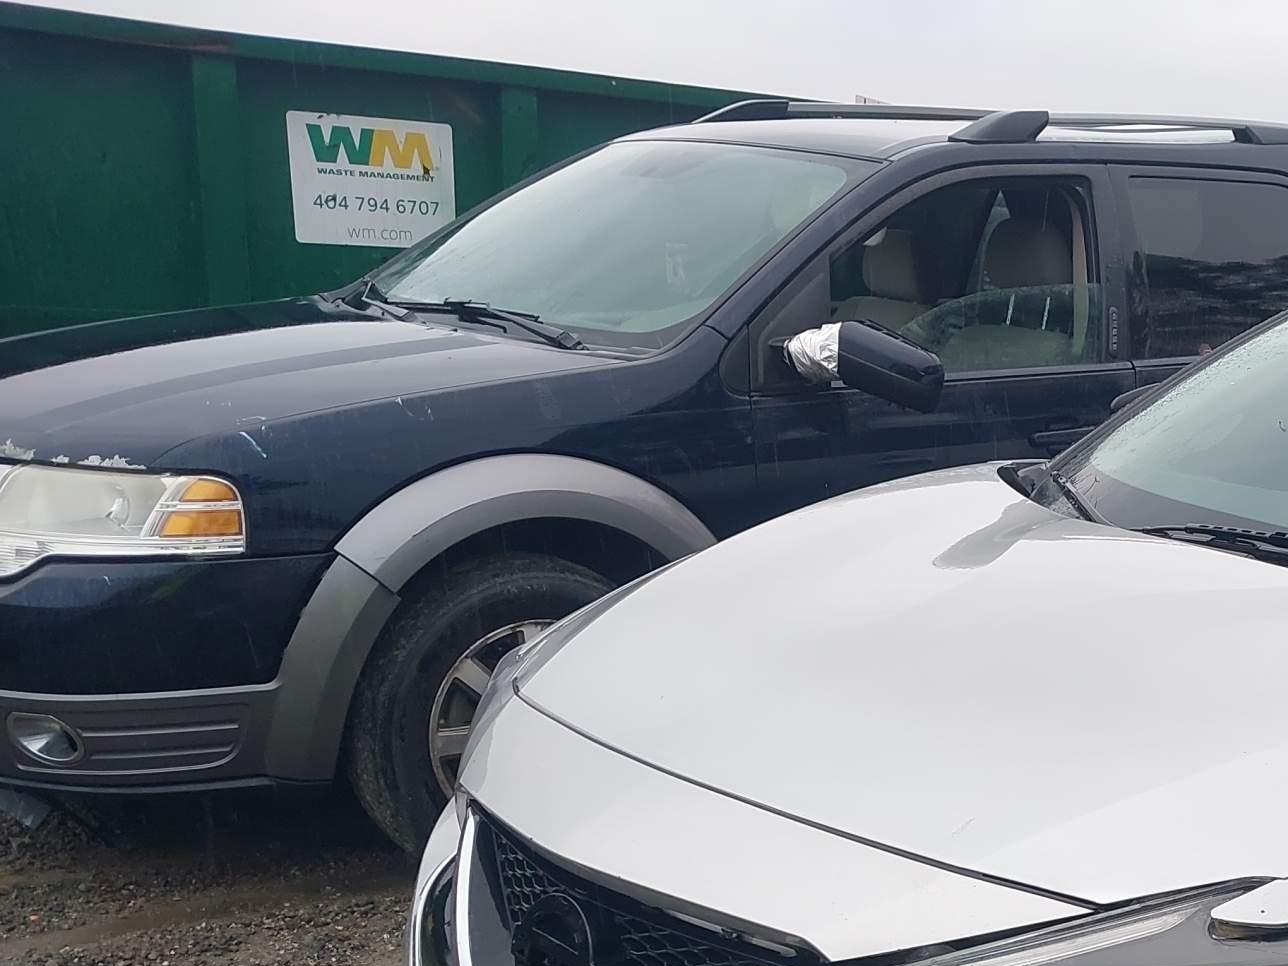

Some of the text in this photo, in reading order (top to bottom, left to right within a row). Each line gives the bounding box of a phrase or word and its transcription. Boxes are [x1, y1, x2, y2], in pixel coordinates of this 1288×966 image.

[305, 123, 433, 171] WM
[317, 167, 436, 183] WASTE MANAGEMENT
[313, 194, 440, 216] 404 794 6707
[347, 226, 413, 241] wm.com
